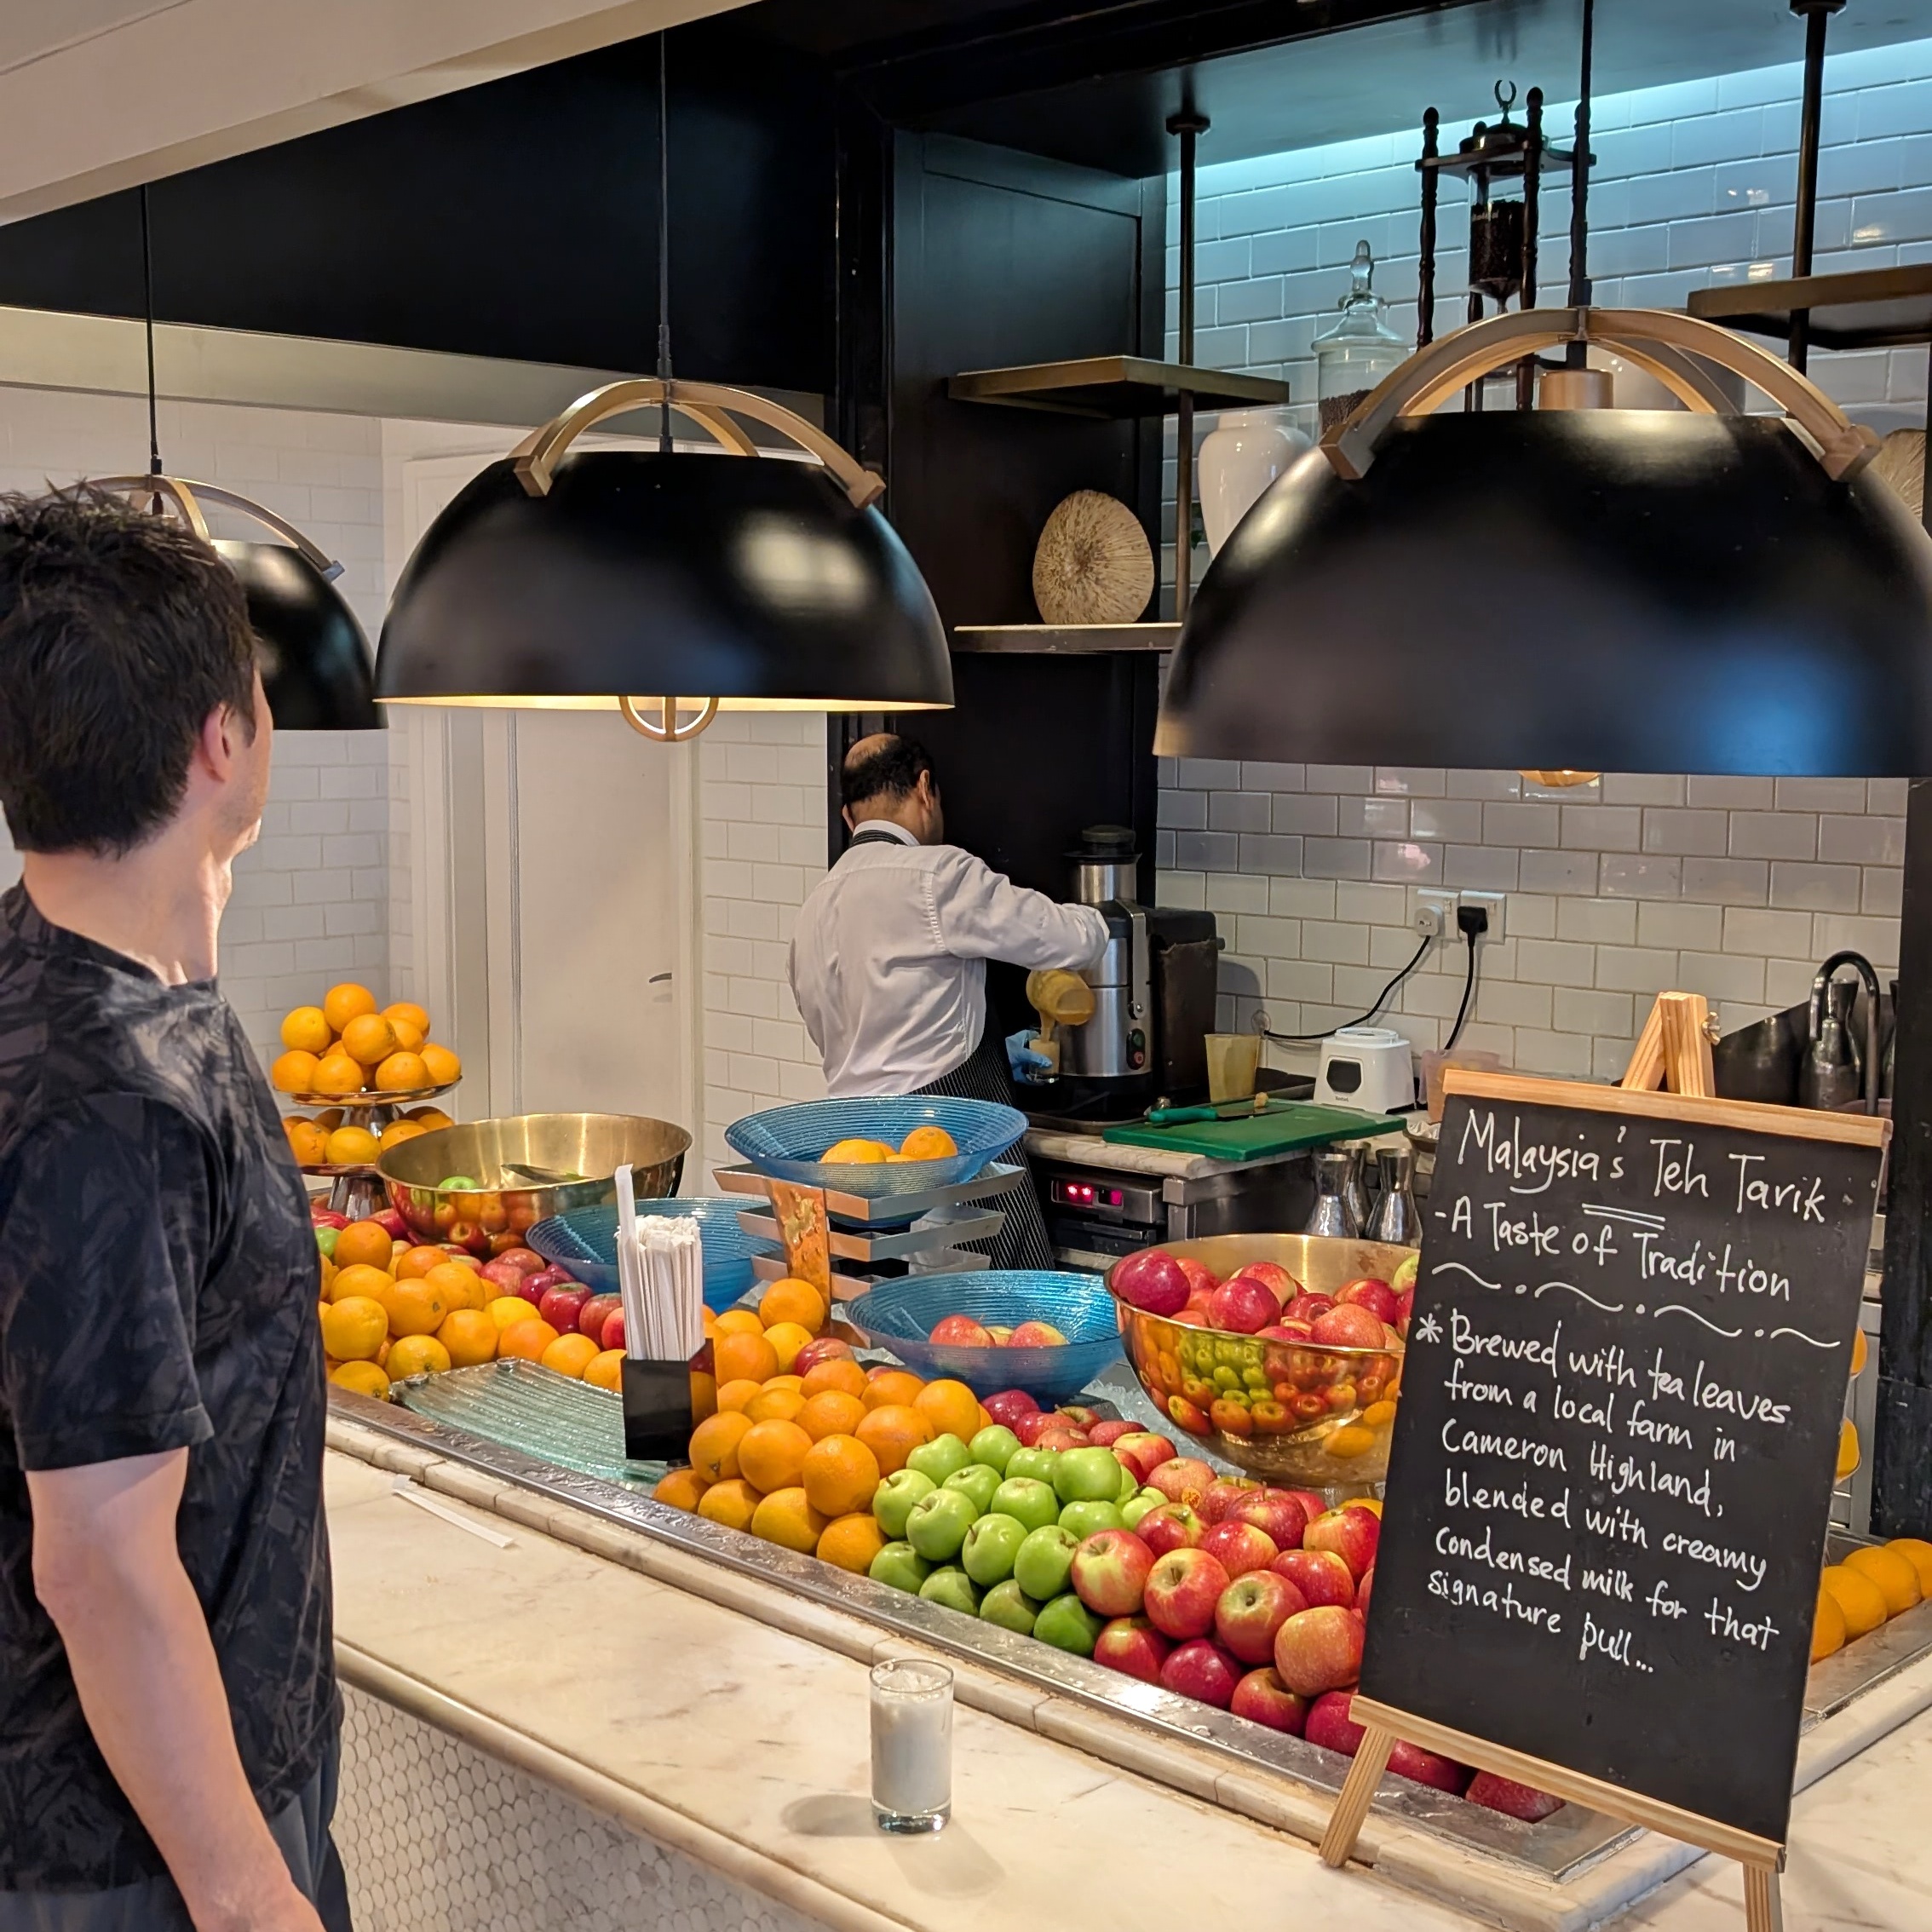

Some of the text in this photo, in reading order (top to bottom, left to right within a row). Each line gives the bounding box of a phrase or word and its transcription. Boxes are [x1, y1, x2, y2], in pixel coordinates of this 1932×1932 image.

[1458, 1109, 1826, 1222] Malaysia's Teh Tarik
[1484, 1202, 1561, 1256] Taste
[1572, 1225, 1619, 1267] of
[1633, 1233, 1791, 1302] Tradition
[1444, 1358, 1735, 1463] from a local farm in
[1451, 1308, 1791, 1424] Brewed with tea leaves
[1441, 1418, 1724, 1518] Cameron Highland,
[1445, 1469, 1767, 1591] blended with creamy
[1582, 1569, 1633, 1602] milk
[1645, 1580, 1688, 1619] for
[1704, 1597, 1780, 1651] that
